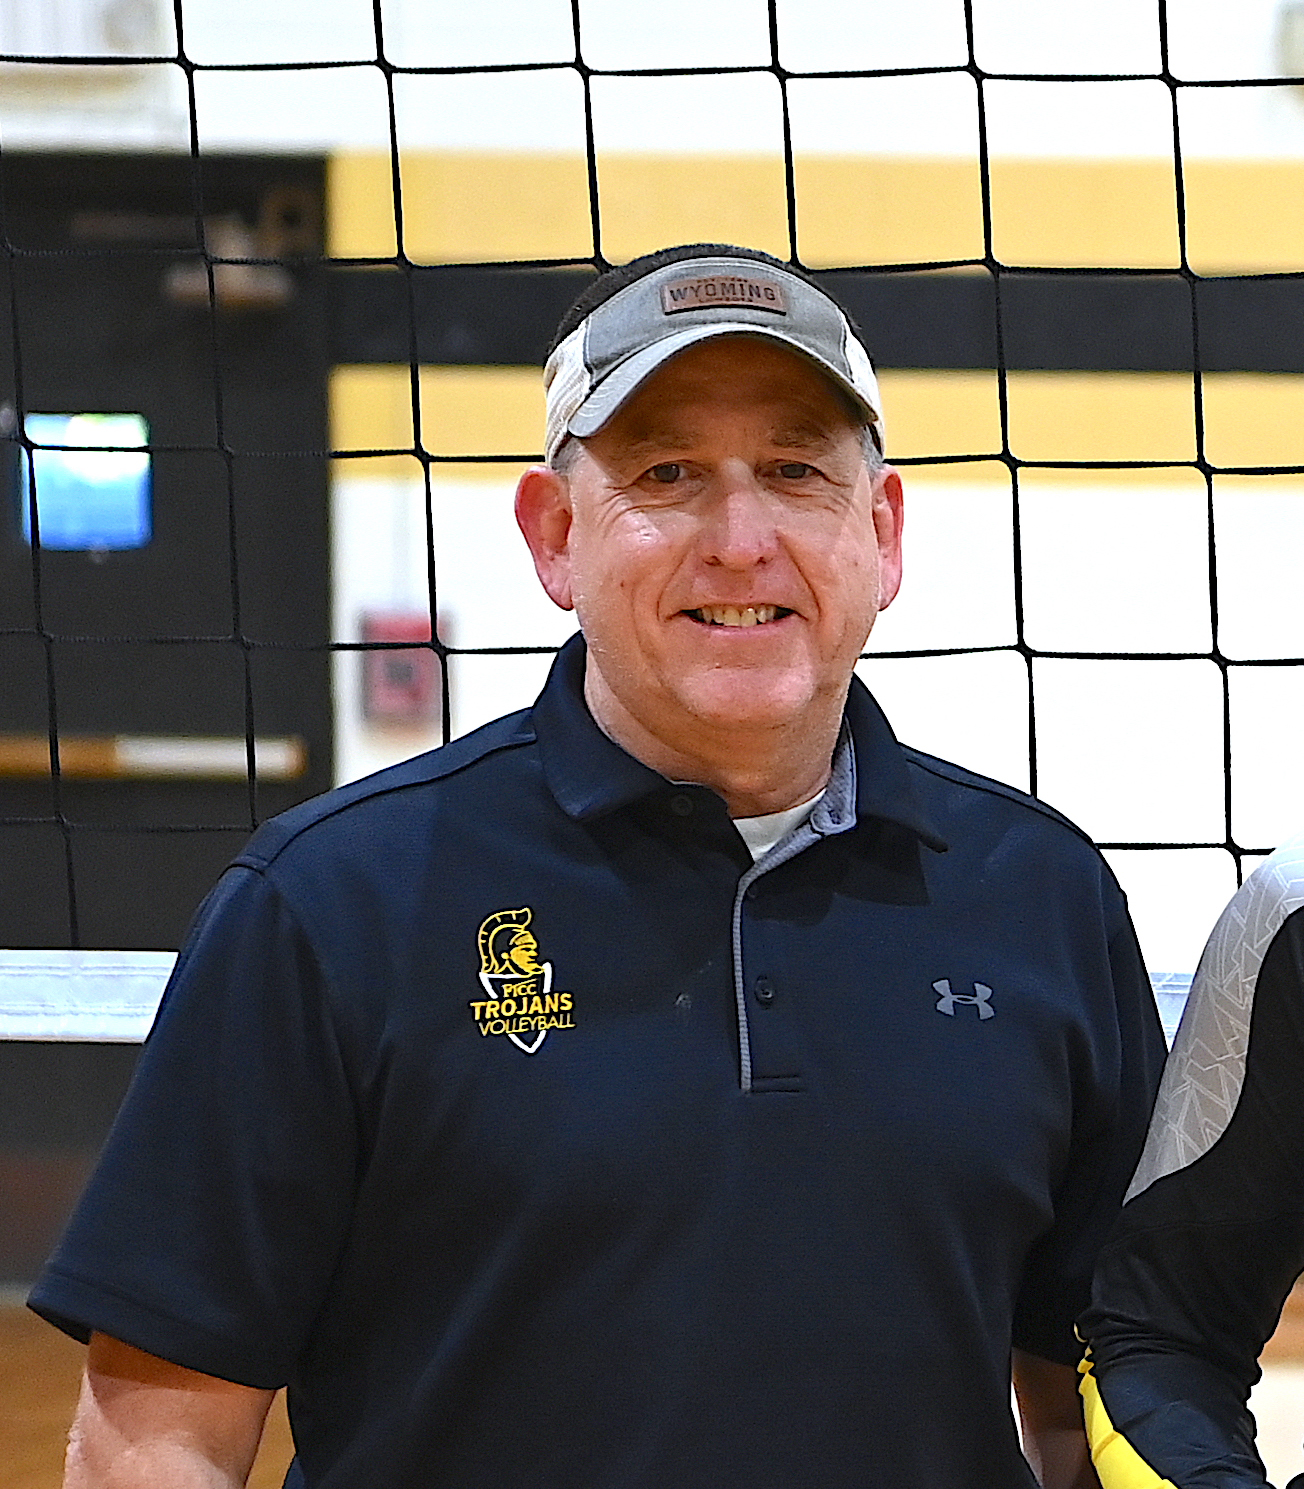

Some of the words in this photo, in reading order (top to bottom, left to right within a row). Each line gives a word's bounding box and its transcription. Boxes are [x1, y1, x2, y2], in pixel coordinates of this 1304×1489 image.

[669, 282, 777, 302] WYOMING
[470, 993, 573, 1020] TROJANS
[479, 1013, 576, 1037] VOLLEYBALL
